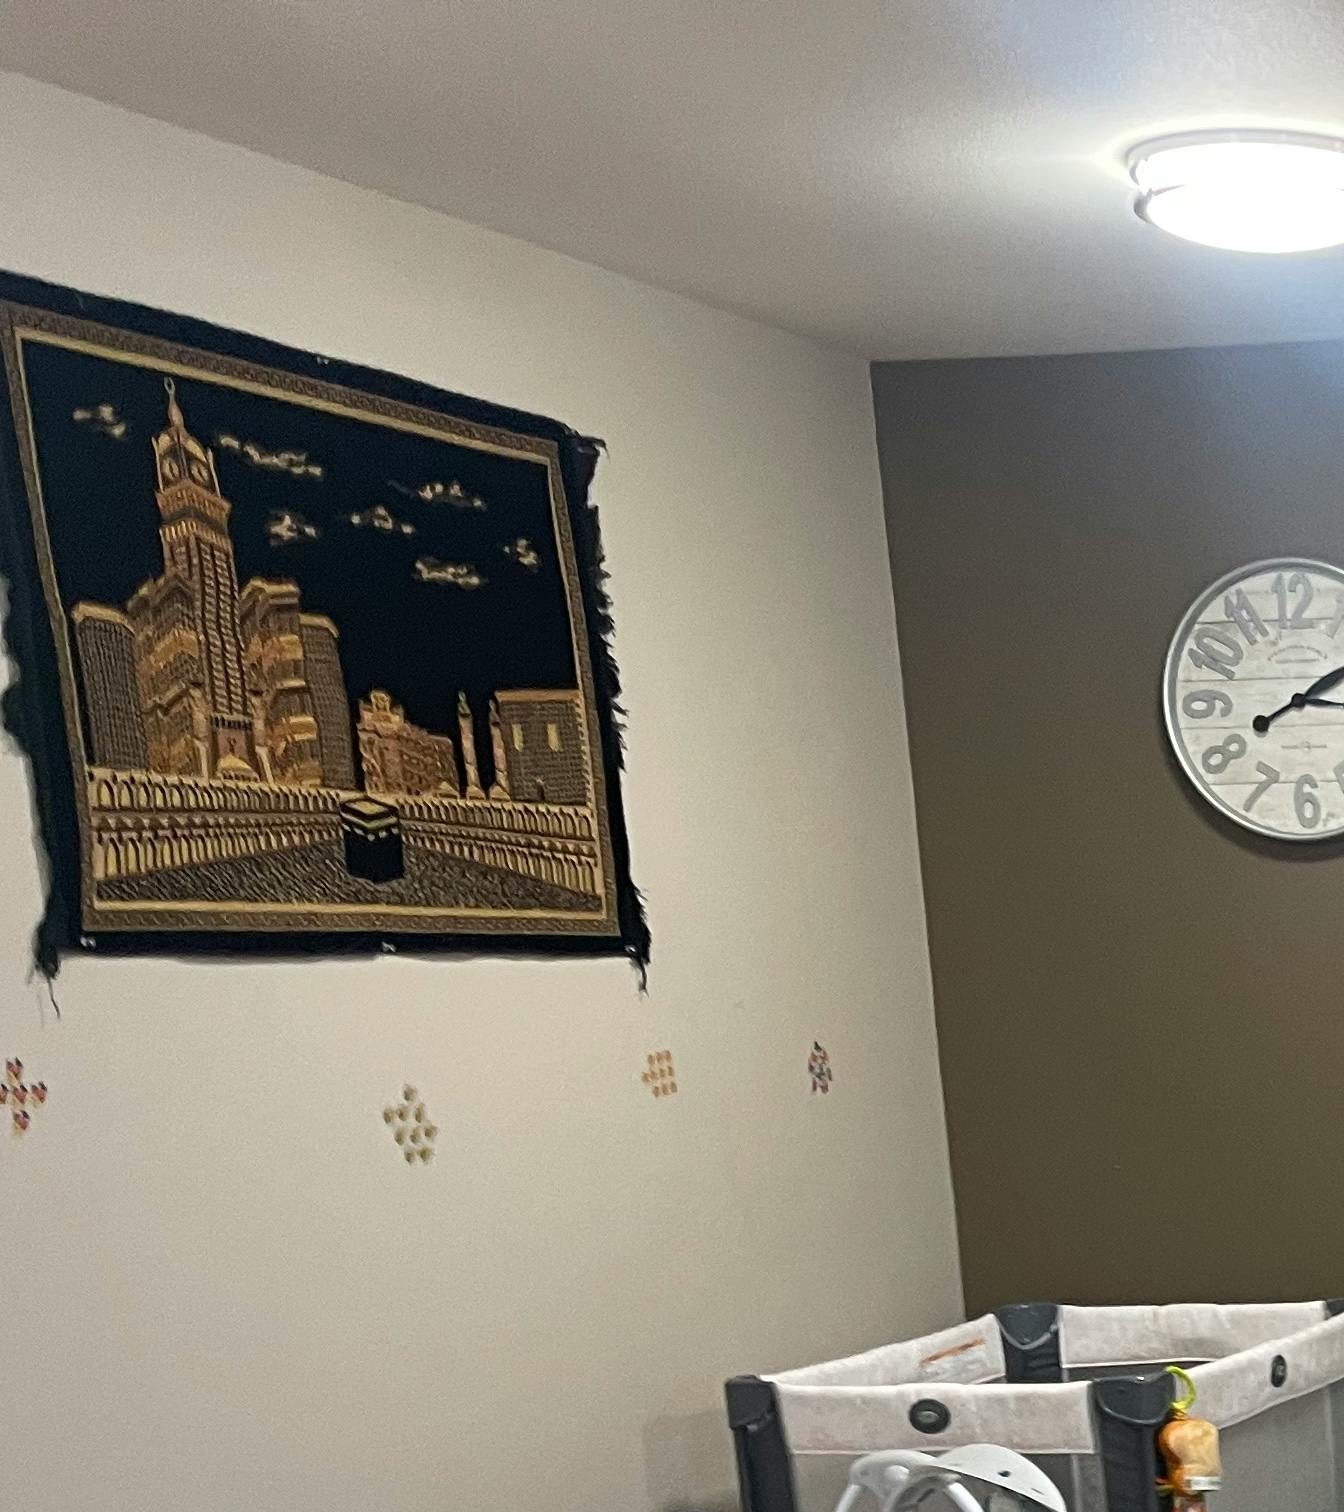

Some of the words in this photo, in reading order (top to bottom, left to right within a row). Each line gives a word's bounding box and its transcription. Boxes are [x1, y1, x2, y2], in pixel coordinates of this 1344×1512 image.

[1224, 587, 1269, 646] 11
[1271, 573, 1316, 630] 12
[1187, 626, 1244, 680] 10
[1182, 689, 1233, 719] 9
[1201, 733, 1247, 775] 8
[1243, 760, 1280, 812] 7
[1293, 773, 1321, 829] 6
